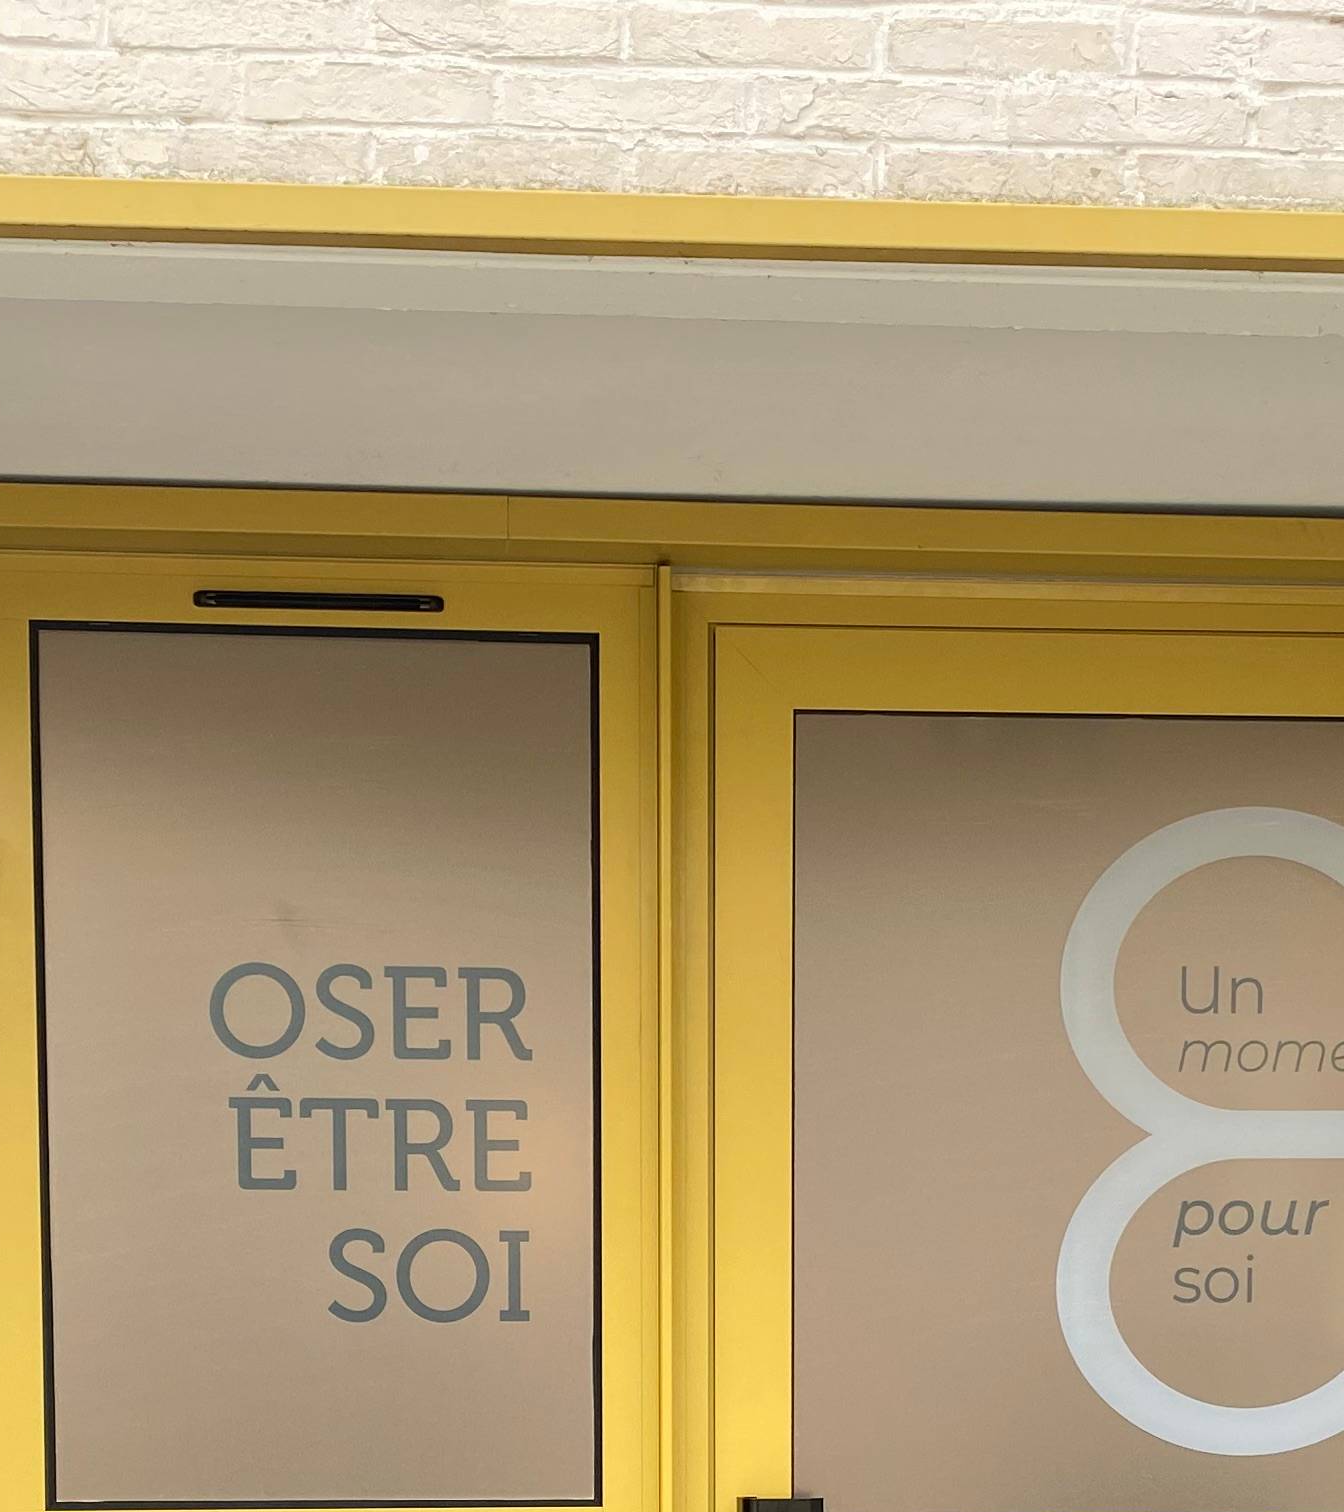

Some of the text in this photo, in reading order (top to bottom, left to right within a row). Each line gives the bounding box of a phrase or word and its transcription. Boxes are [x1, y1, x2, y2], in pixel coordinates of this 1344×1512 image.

[209, 962, 533, 1061] OSER
[1180, 966, 1263, 1014] Un
[228, 1074, 532, 1192] ÊTRE
[1173, 1198, 1330, 1247] pour
[328, 1228, 530, 1323] SOI
[1172, 1255, 1255, 1303] soi
